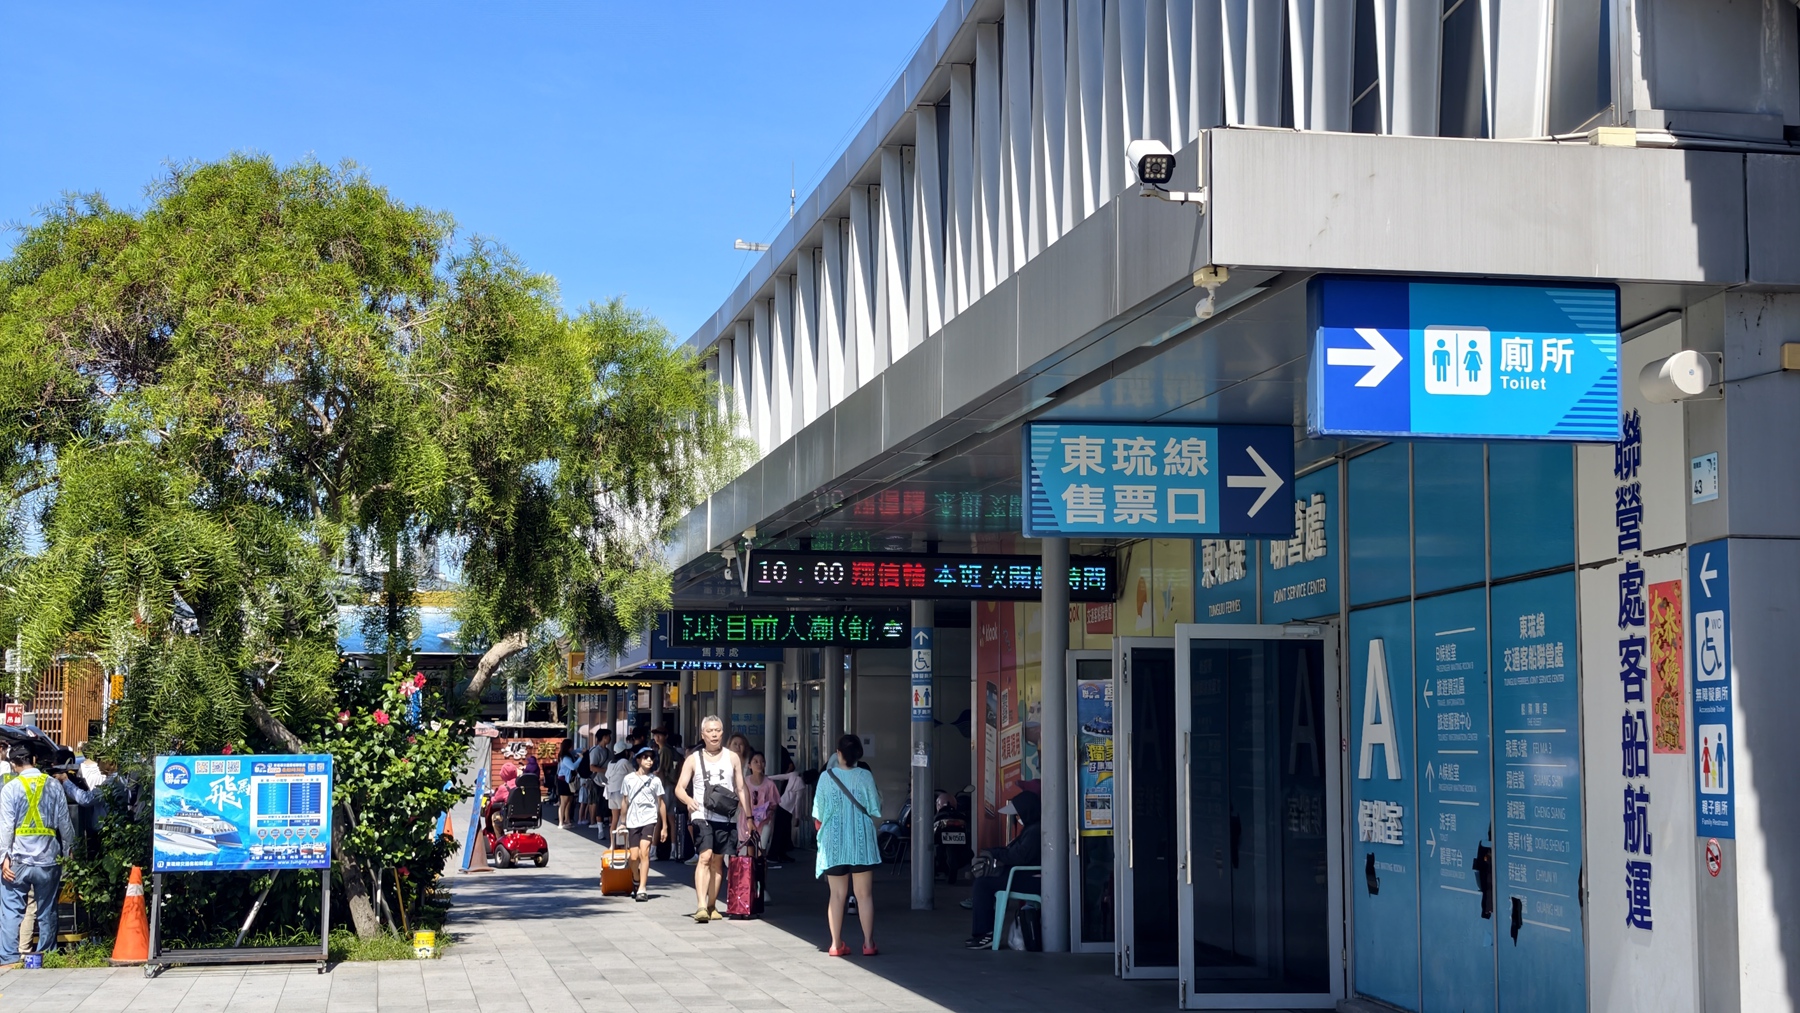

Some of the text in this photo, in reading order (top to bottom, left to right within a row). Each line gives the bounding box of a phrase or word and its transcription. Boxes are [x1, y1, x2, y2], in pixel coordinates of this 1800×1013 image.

[1500, 337, 1575, 374] 廁所
[1500, 375, 1547, 391] Toilet
[1060, 435, 1209, 477] 東琉線
[1694, 479, 1703, 495] 43
[1060, 484, 1206, 525] 售票口
[1287, 583, 1307, 601] SERVICE
[1307, 578, 1327, 597] CENTER
[985, 622, 998, 642] klook
[1519, 611, 1546, 640] 東琉線
[1649, 588, 1665, 664] 大家
[1711, 618, 1721, 629] WC
[701, 647, 740, 658] 售票處
[1504, 641, 1564, 673] 交通客船聯營處
[1613, 409, 1653, 931] 聯營處客船航運
[1695, 686, 1729, 702] 無障礙廁所
[1358, 639, 1402, 780] A
[1534, 805, 1550, 819] CHENG
[1701, 800, 1728, 816] 親子廁所
[1701, 817, 1729, 827] Family Restroom
